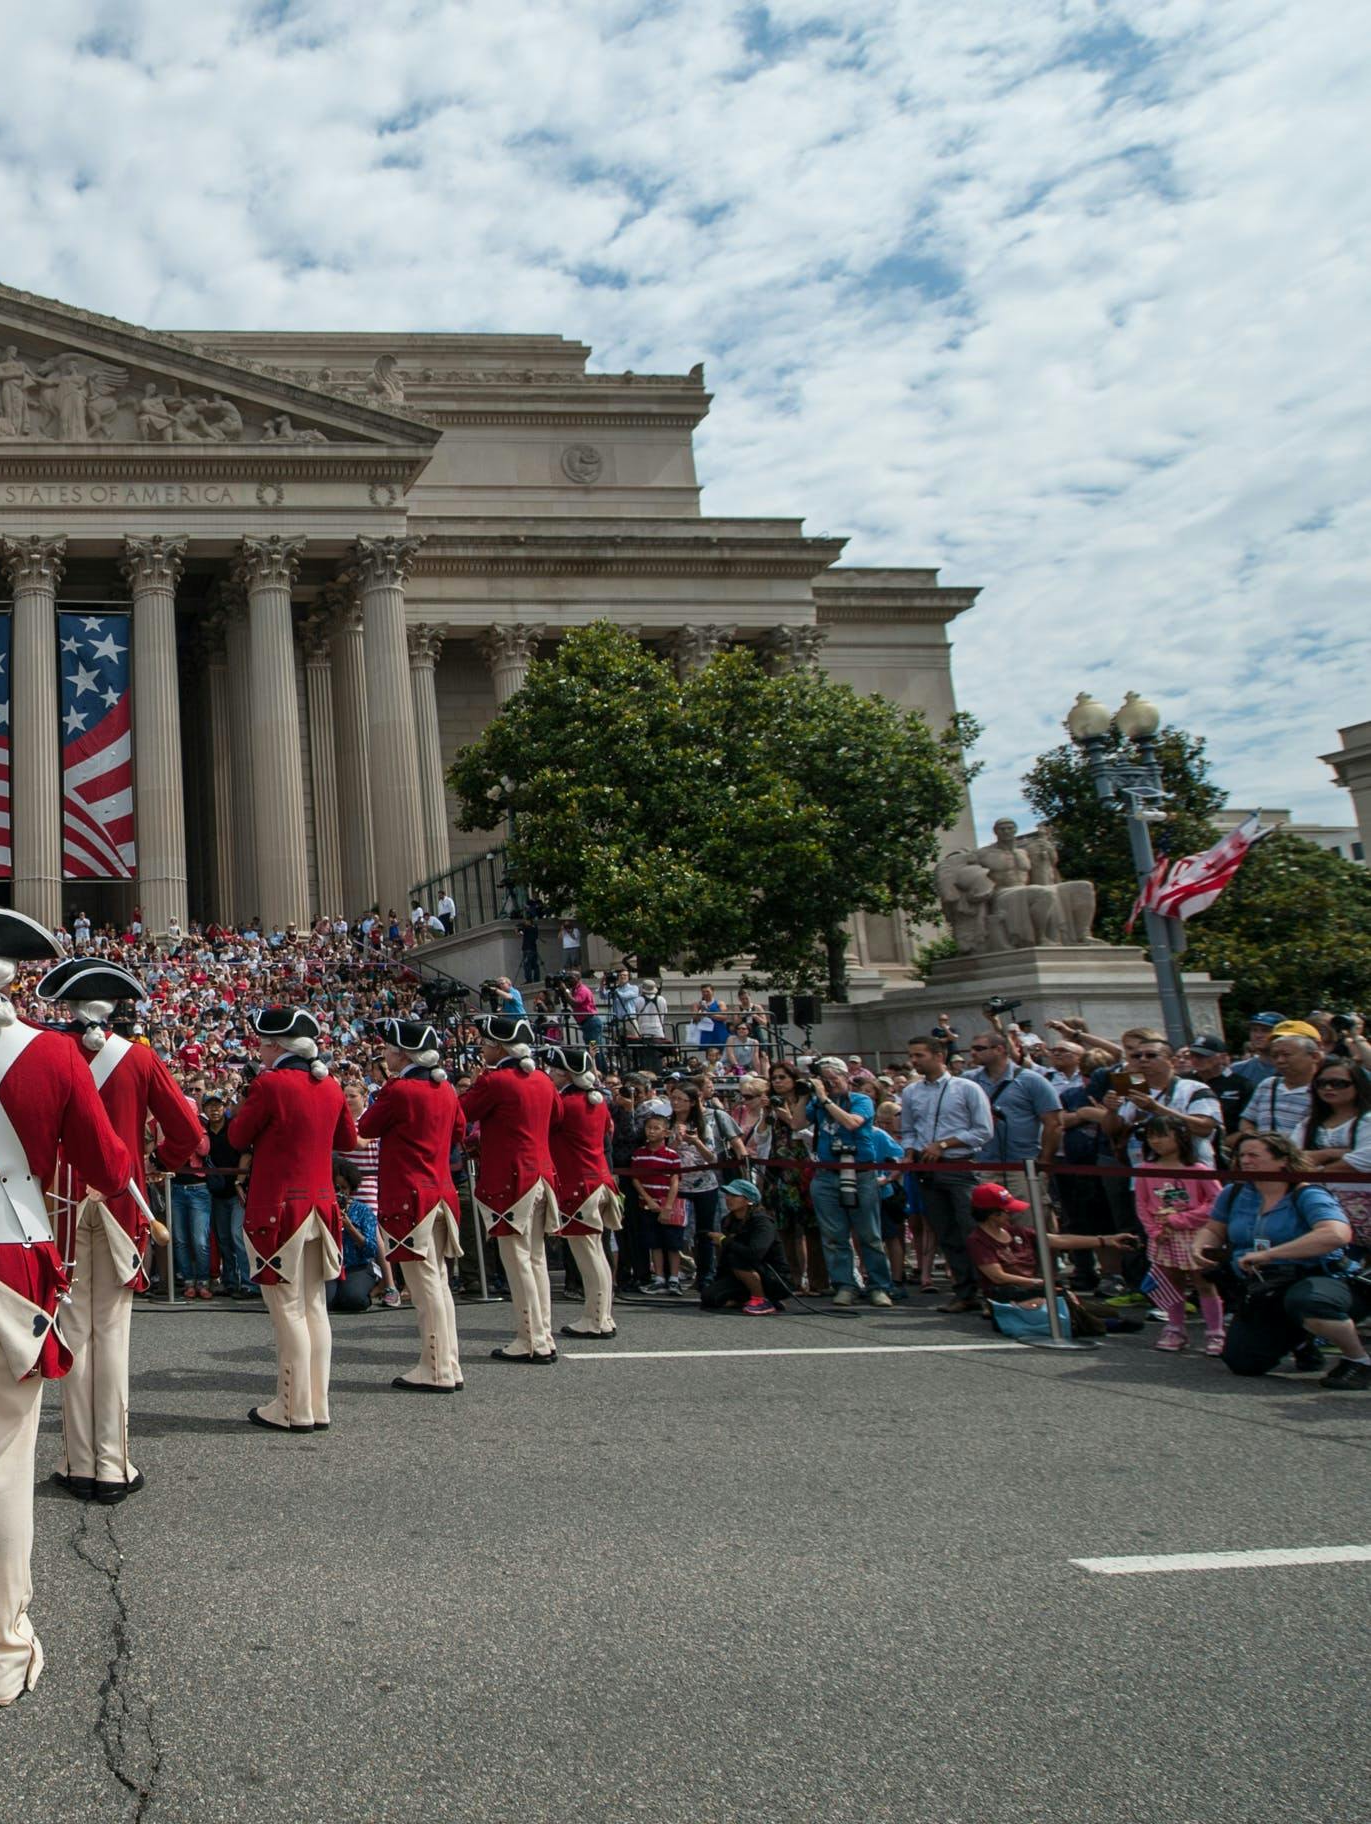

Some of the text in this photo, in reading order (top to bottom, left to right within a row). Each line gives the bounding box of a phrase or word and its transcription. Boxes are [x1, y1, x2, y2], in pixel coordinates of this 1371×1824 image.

[5, 486, 82, 503] STATES
[90, 486, 119, 503] OF
[125, 486, 235, 503] AMERICA
